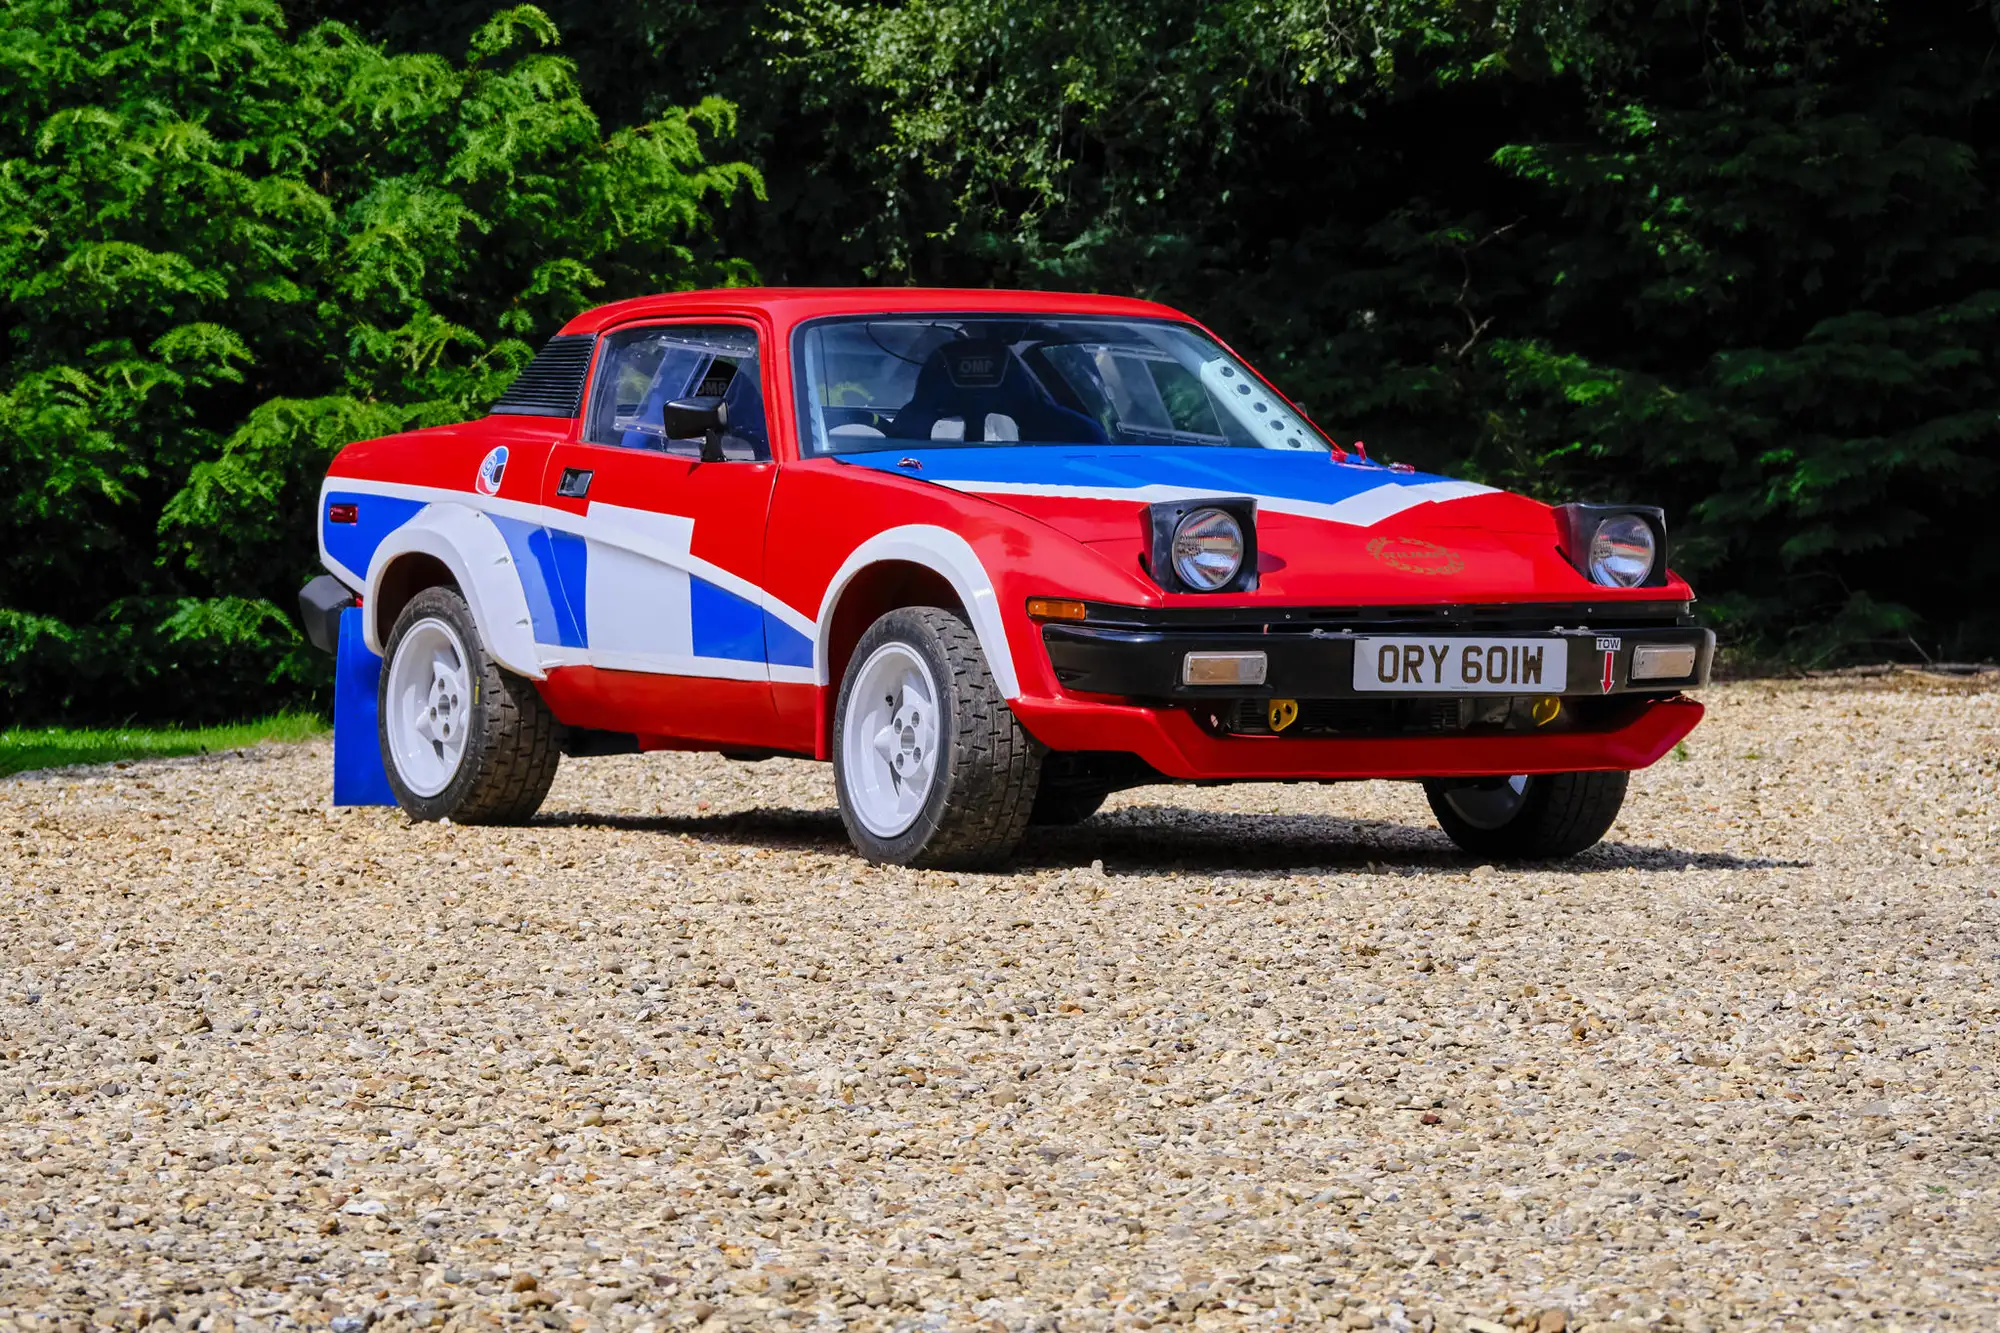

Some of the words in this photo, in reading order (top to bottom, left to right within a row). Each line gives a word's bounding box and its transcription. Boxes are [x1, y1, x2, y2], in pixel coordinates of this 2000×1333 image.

[960, 360, 994, 373] OMP
[1597, 639, 1620, 649] TOW
[1378, 644, 1449, 684] ORY
[1461, 645, 1544, 684] 601W
